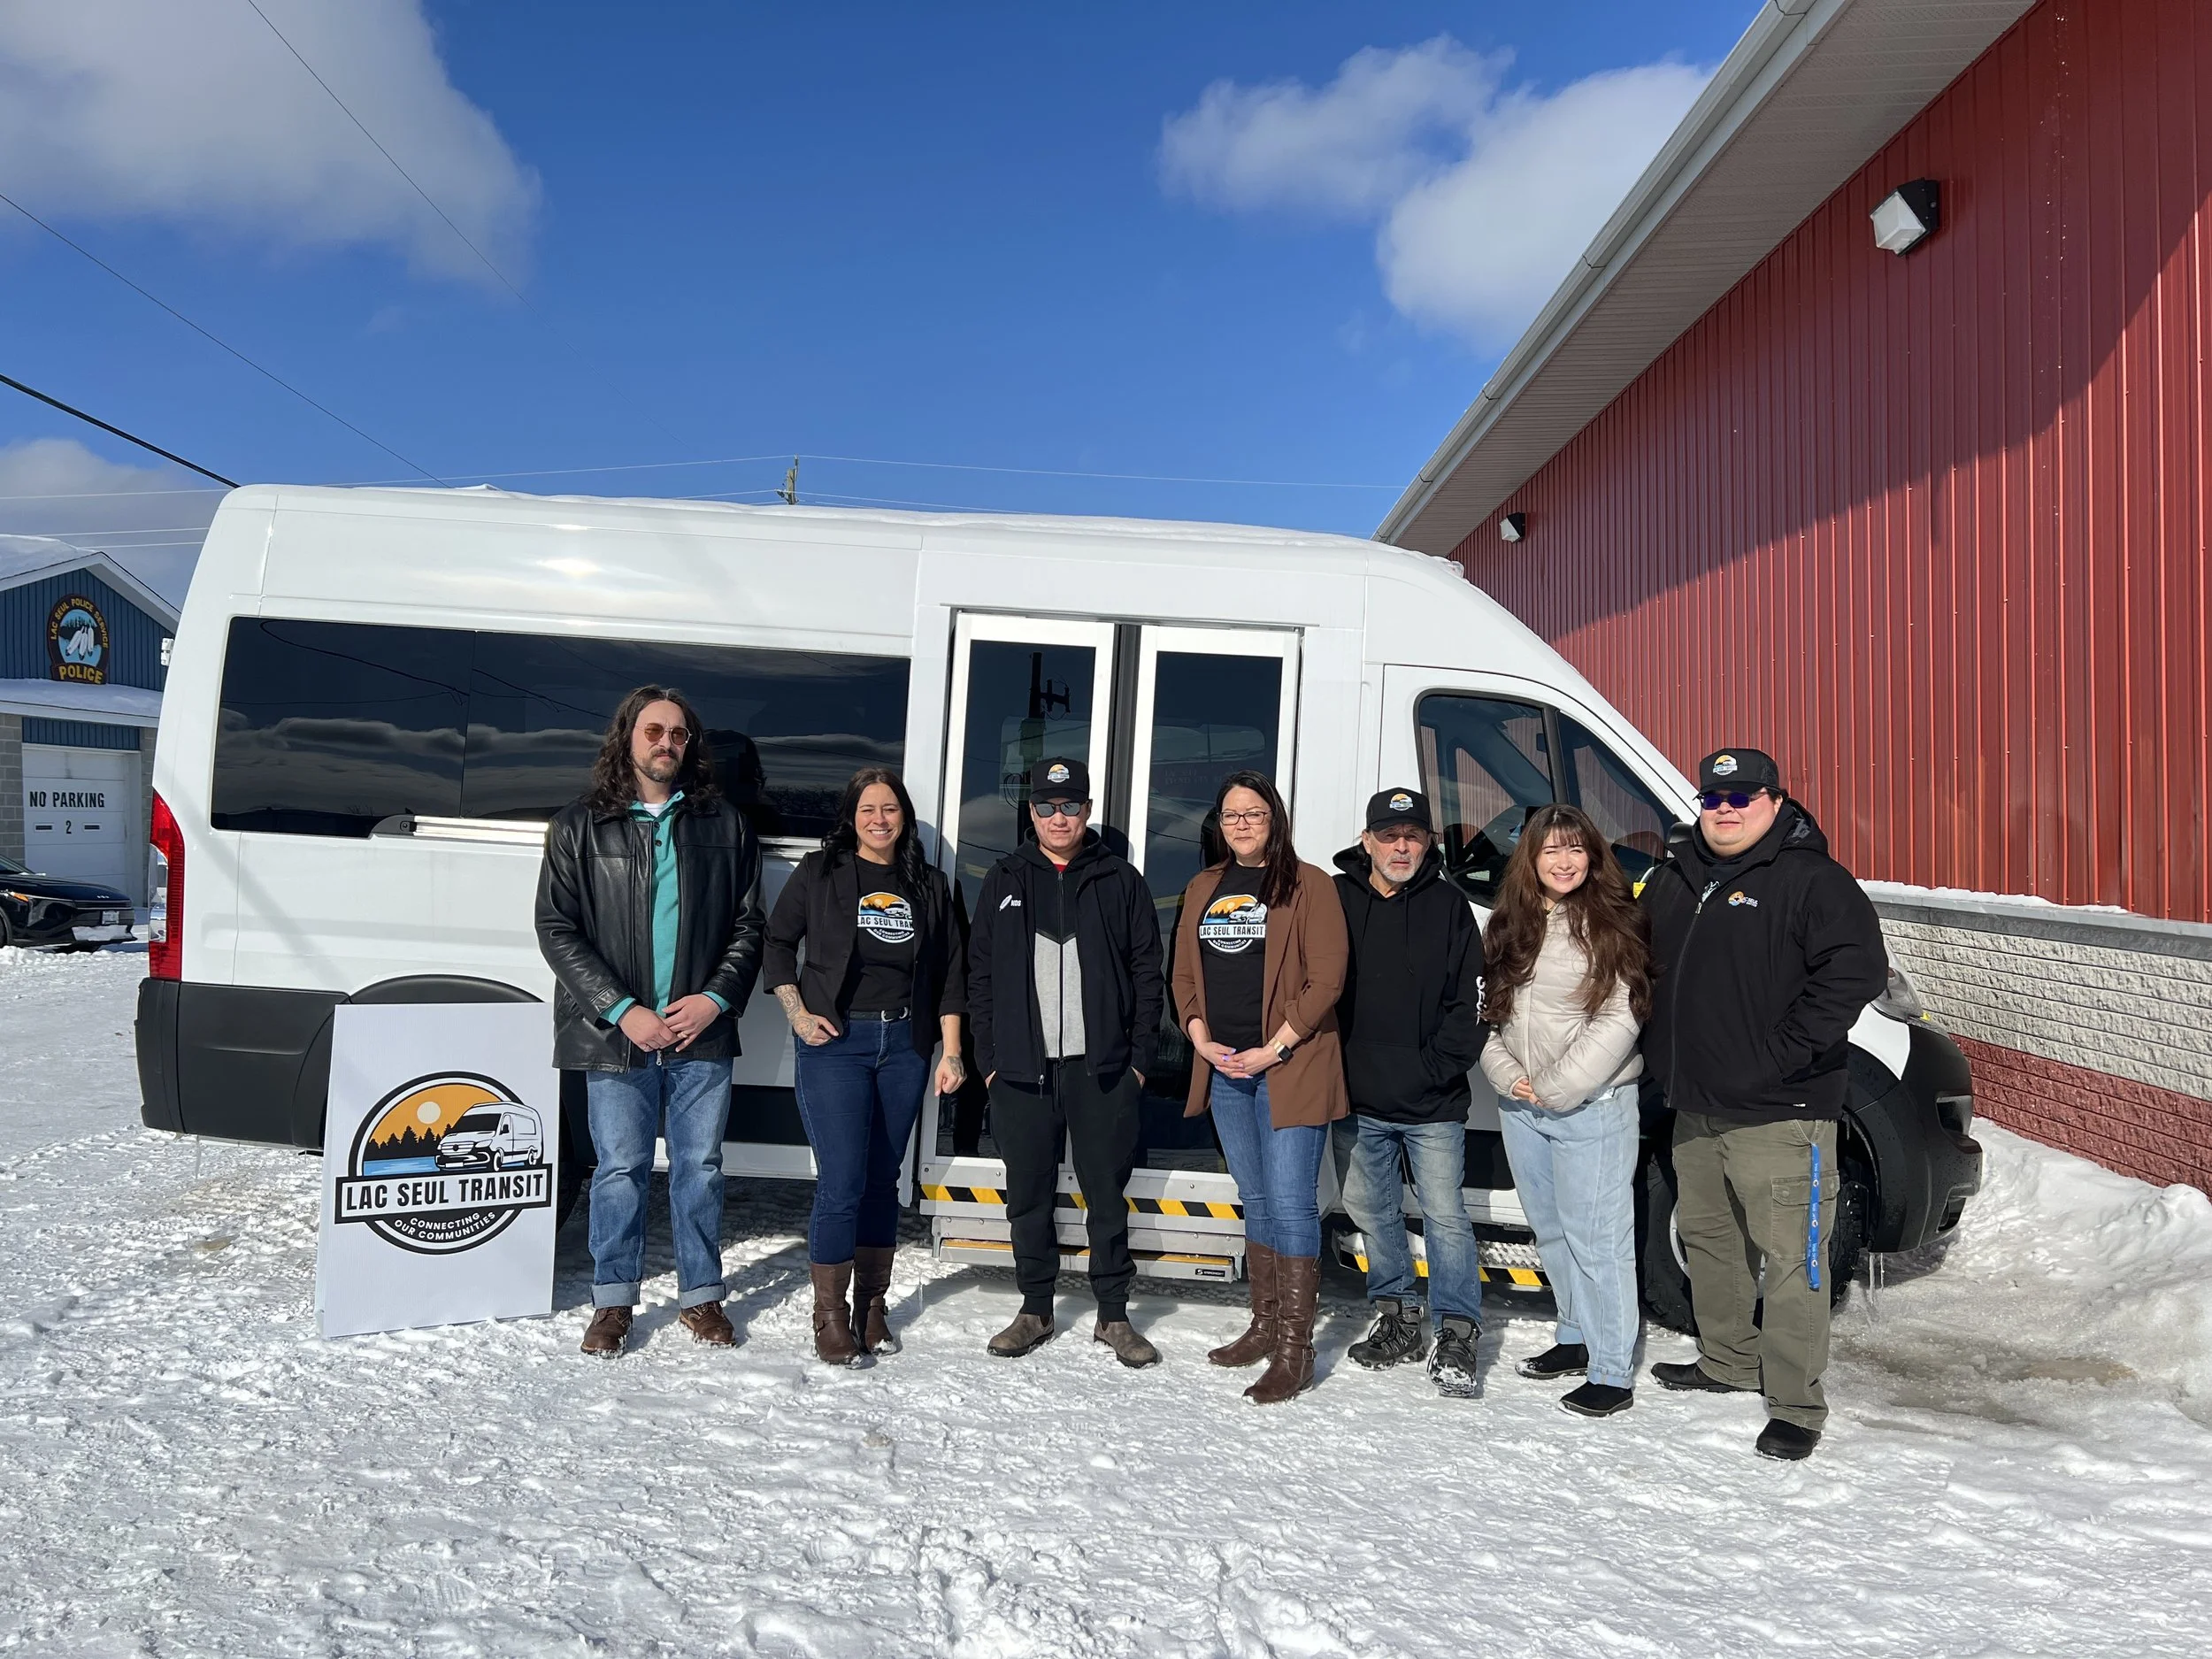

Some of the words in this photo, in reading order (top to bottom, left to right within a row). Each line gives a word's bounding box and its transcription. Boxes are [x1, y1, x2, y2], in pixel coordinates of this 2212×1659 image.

[54, 602, 70, 620] SEUL
[71, 598, 94, 612] POLICE
[94, 611, 109, 649] SERVICE
[58, 664, 104, 685] POLICE
[29, 791, 47, 807] NO
[52, 791, 104, 808] PARKING
[65, 820, 72, 834] 2
[874, 917, 893, 927] SEUL
[1200, 926, 1211, 936] LAC
[1213, 926, 1230, 935] SEUL
[1233, 926, 1263, 935] TRANSIT
[346, 1184, 388, 1210] LAC
[396, 1180, 449, 1207] SEUL
[458, 1173, 543, 1202] TRANSIT
[394, 1218, 416, 1236] OUR
[418, 1211, 496, 1240] COMMUNITIES
[410, 1211, 480, 1230] CONNECTING
